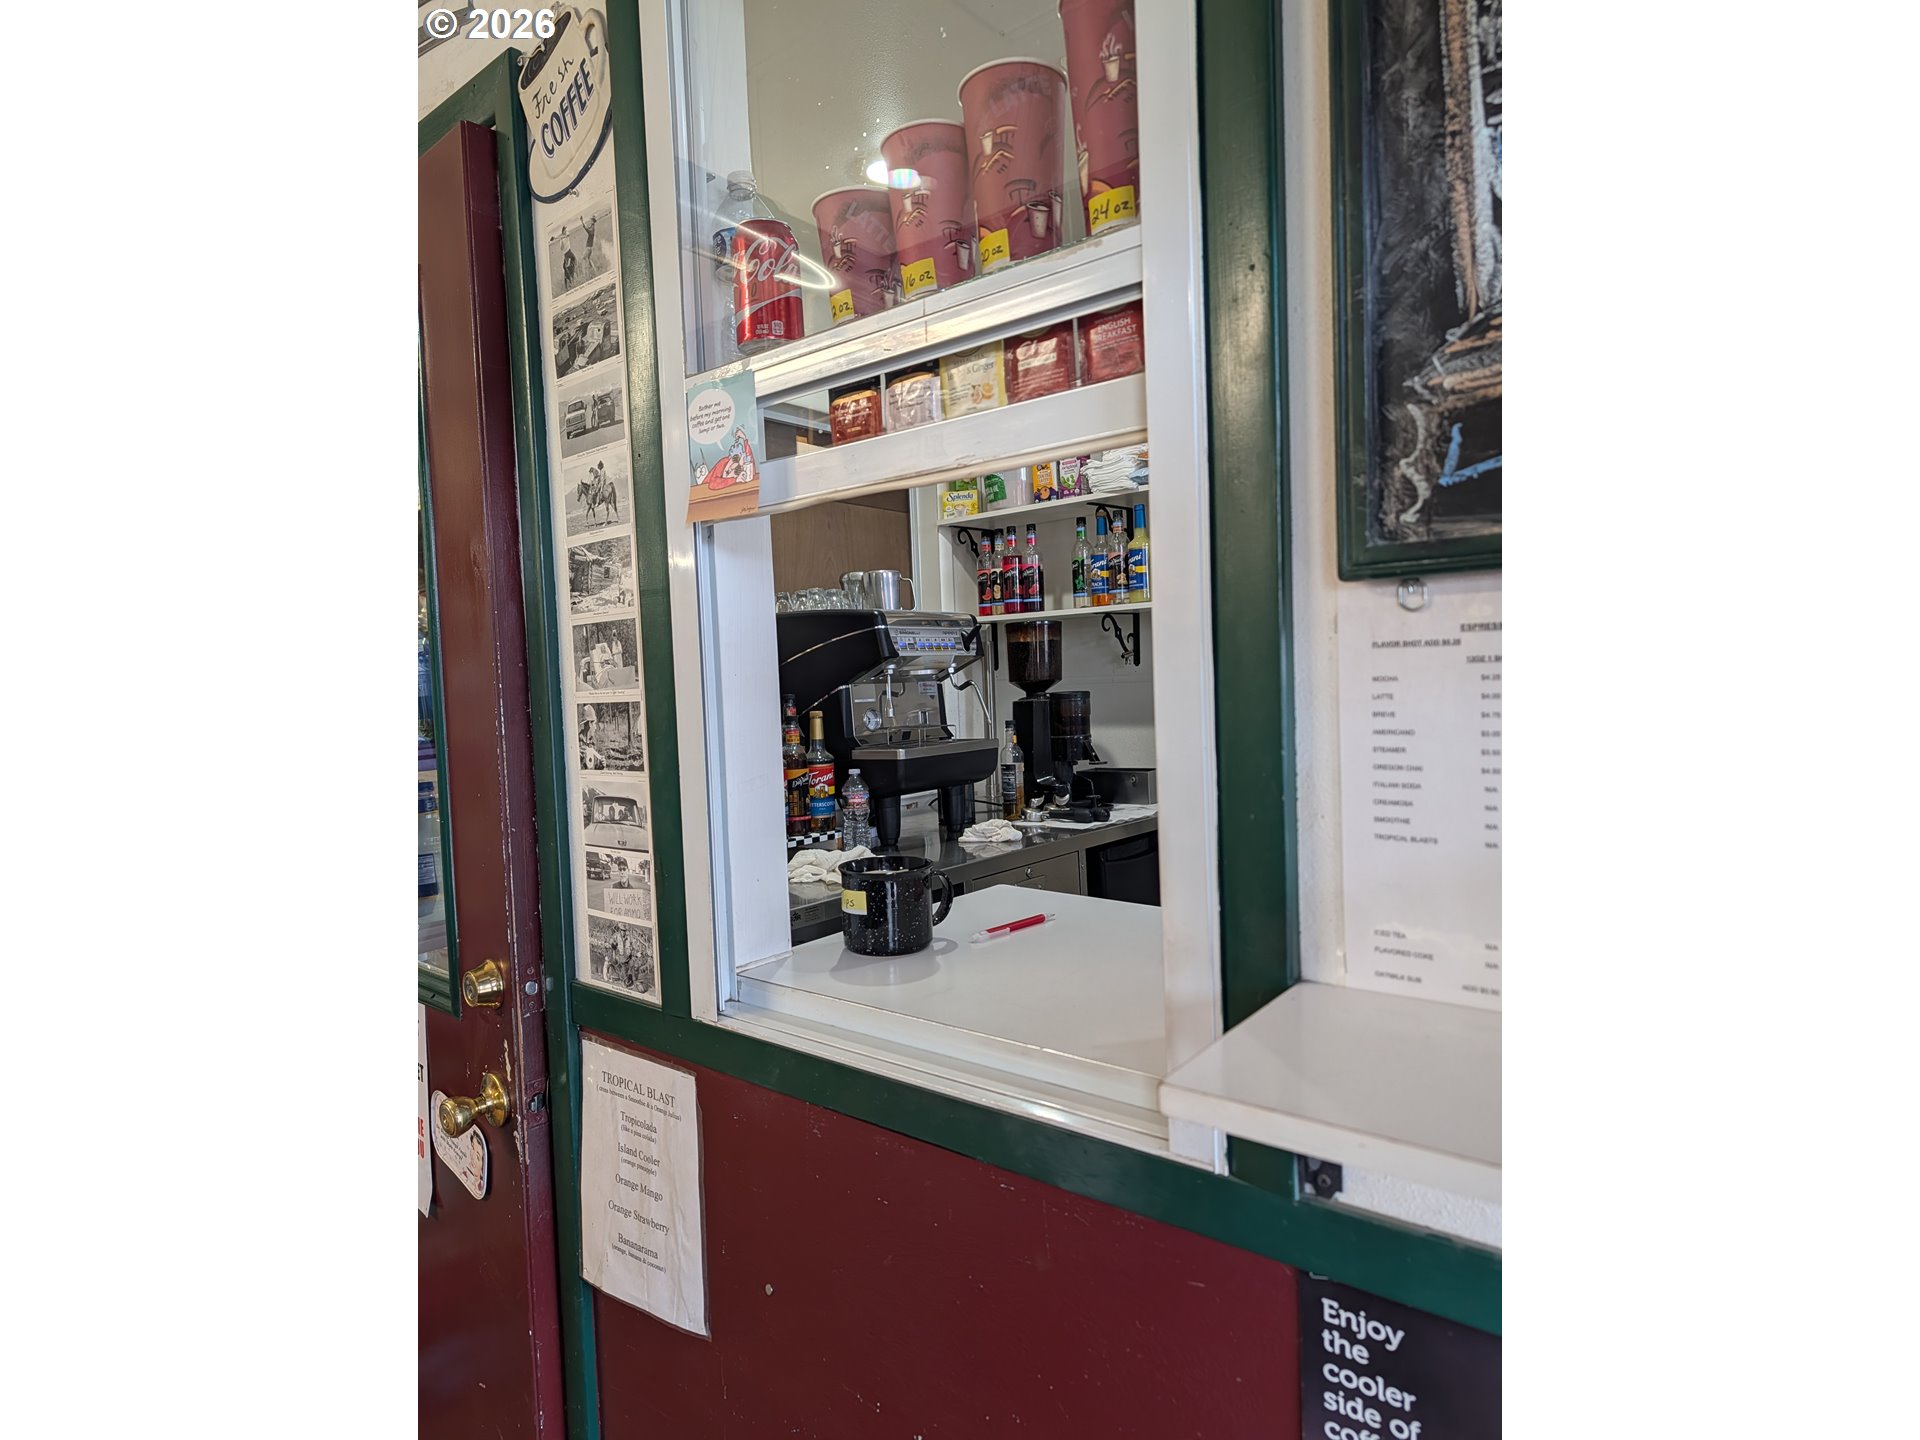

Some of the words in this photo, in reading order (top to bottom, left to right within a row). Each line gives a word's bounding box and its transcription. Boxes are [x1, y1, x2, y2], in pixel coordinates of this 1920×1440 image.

[532, 57, 574, 119] Fresh
[540, 58, 594, 157] COFFEE
[1092, 199, 1109, 225] 24
[905, 274, 916, 288] 16
[1094, 324, 1137, 342] REAKFAST
[1097, 317, 1131, 333] ENGLISH
[972, 361, 994, 374] Ginger
[690, 413, 703, 422] before
[712, 406, 732, 415] morning
[692, 420, 704, 429] coffee
[705, 417, 714, 425] and
[947, 492, 973, 503] Splenda
[808, 769, 834, 785] Torani
[608, 892, 622, 905] WILL
[624, 892, 641, 906] WORK
[602, 1070, 645, 1096] TROPICAL
[647, 1086, 675, 1108] BLAST
[620, 1111, 657, 1134] Tropicolada
[618, 1142, 637, 1158] Island
[639, 1150, 661, 1167] Cooler
[615, 1173, 639, 1192] Orange
[640, 1183, 663, 1202] Mango
[608, 1200, 632, 1219] Orange
[633, 1210, 669, 1236] Strawberry
[618, 1232, 658, 1259] Bananarama
[1321, 1297, 1405, 1352] Enjoy
[1321, 1328, 1370, 1365] the
[1322, 1363, 1416, 1412] cooler
[1323, 1391, 1382, 1429] side
[1389, 1418, 1422, 1440] of
